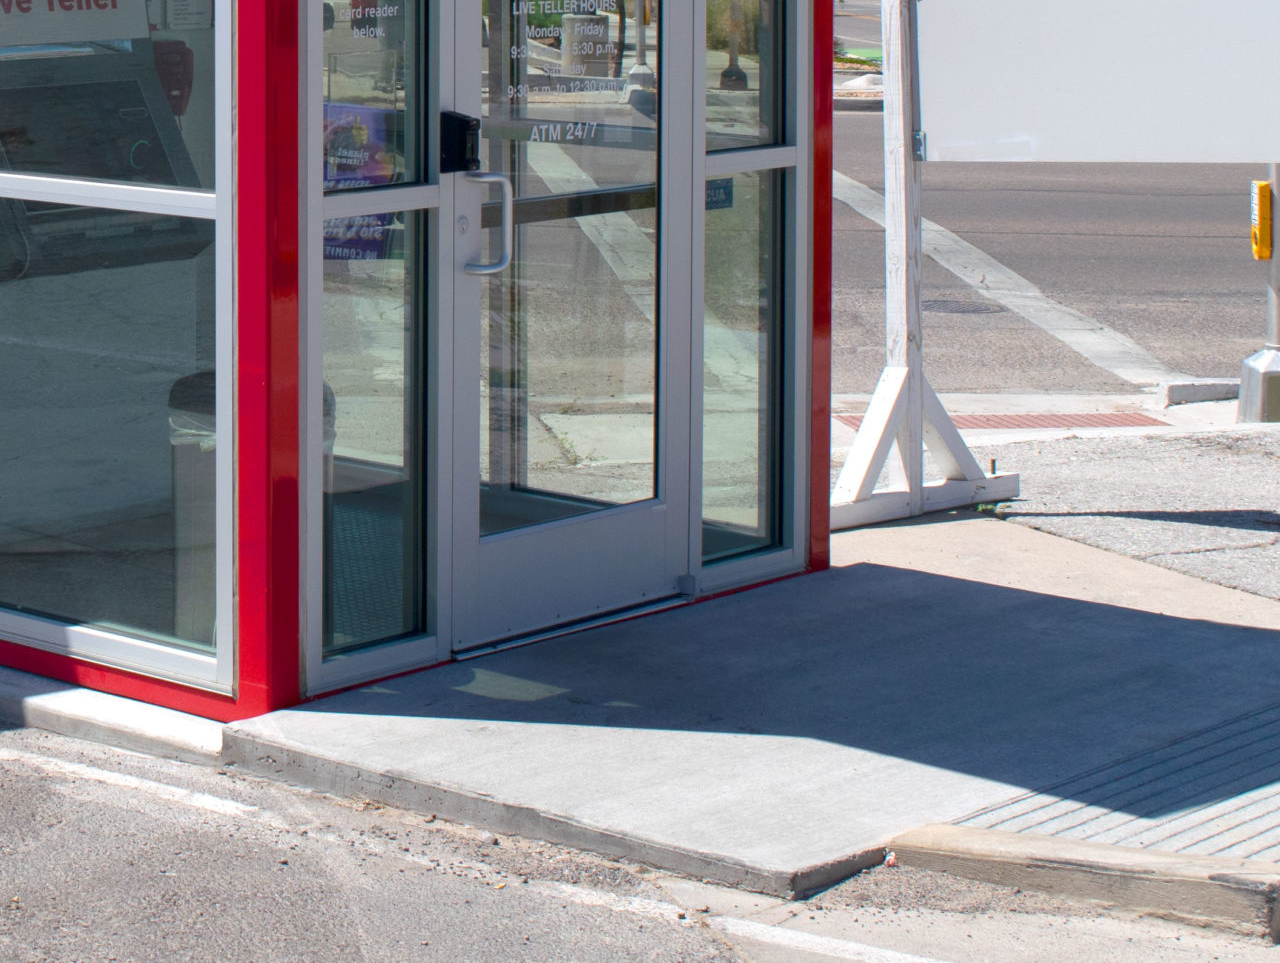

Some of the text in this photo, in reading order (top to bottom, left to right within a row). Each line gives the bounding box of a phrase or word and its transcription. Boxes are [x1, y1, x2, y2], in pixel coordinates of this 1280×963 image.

[339, 4, 399, 19] card reader
[513, 1, 535, 15] LIVE
[538, 0, 578, 14] TELLER
[353, 24, 386, 38] below.
[526, 22, 605, 39] Monday Friday
[572, 42, 594, 55] 5:30
[507, 84, 529, 98] 9:30
[556, 84, 567, 95] to
[570, 80, 596, 93] 12:30
[529, 121, 598, 142] ATM 24/7
